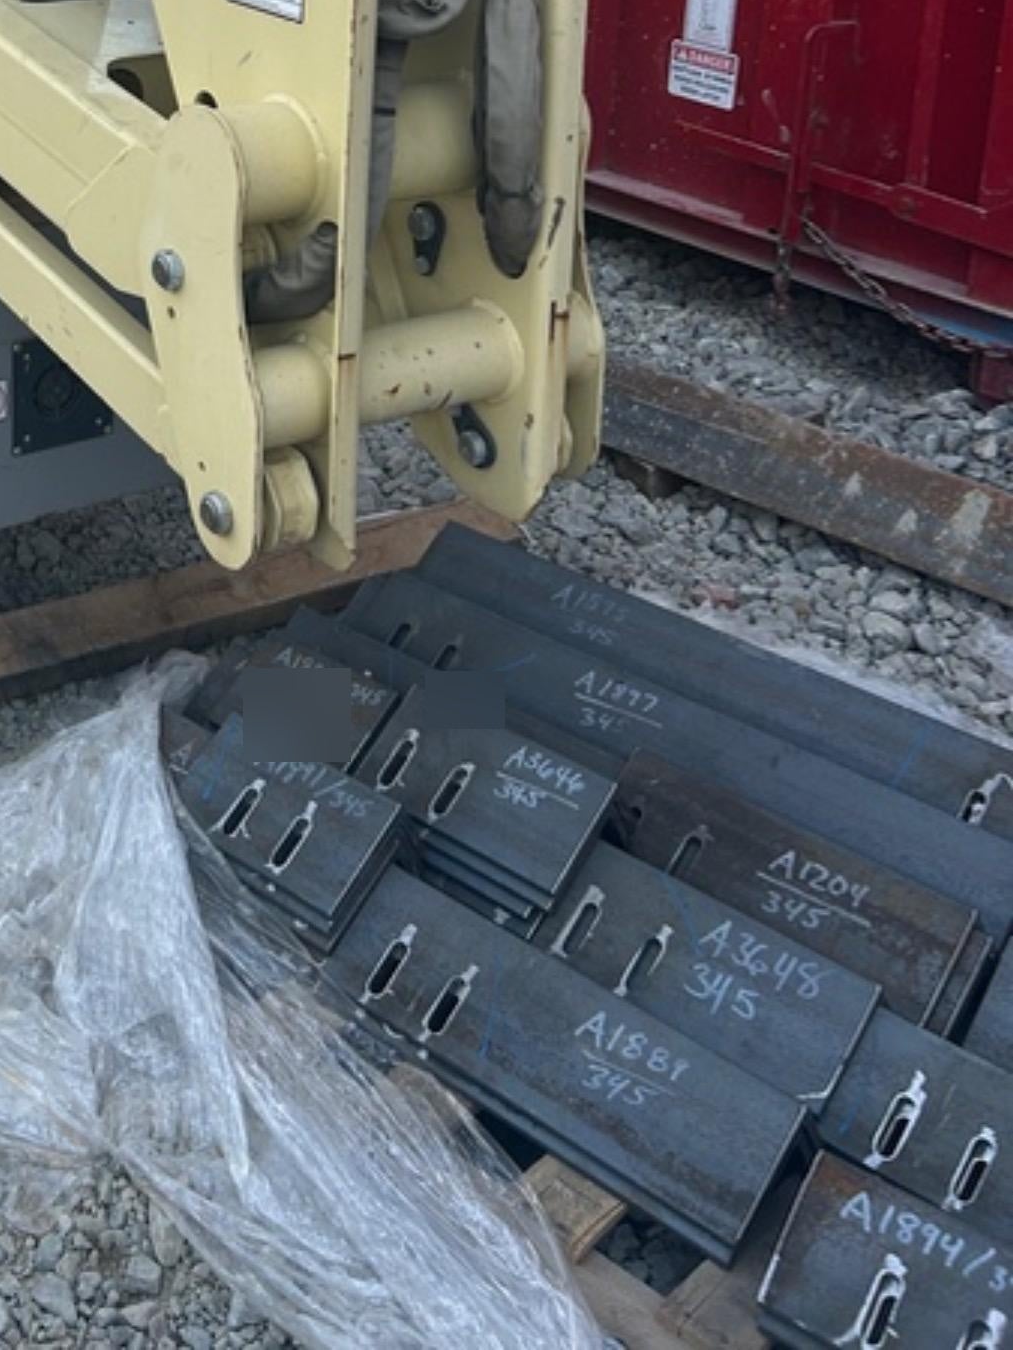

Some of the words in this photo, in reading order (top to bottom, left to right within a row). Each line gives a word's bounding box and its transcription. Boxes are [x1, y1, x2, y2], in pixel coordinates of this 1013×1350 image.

[760, 890, 831, 928] 345
[699, 920, 828, 999] A3648
[684, 962, 759, 1020] 345
[581, 1064, 659, 1105] 345
[839, 1190, 1013, 1292] A1894/3
